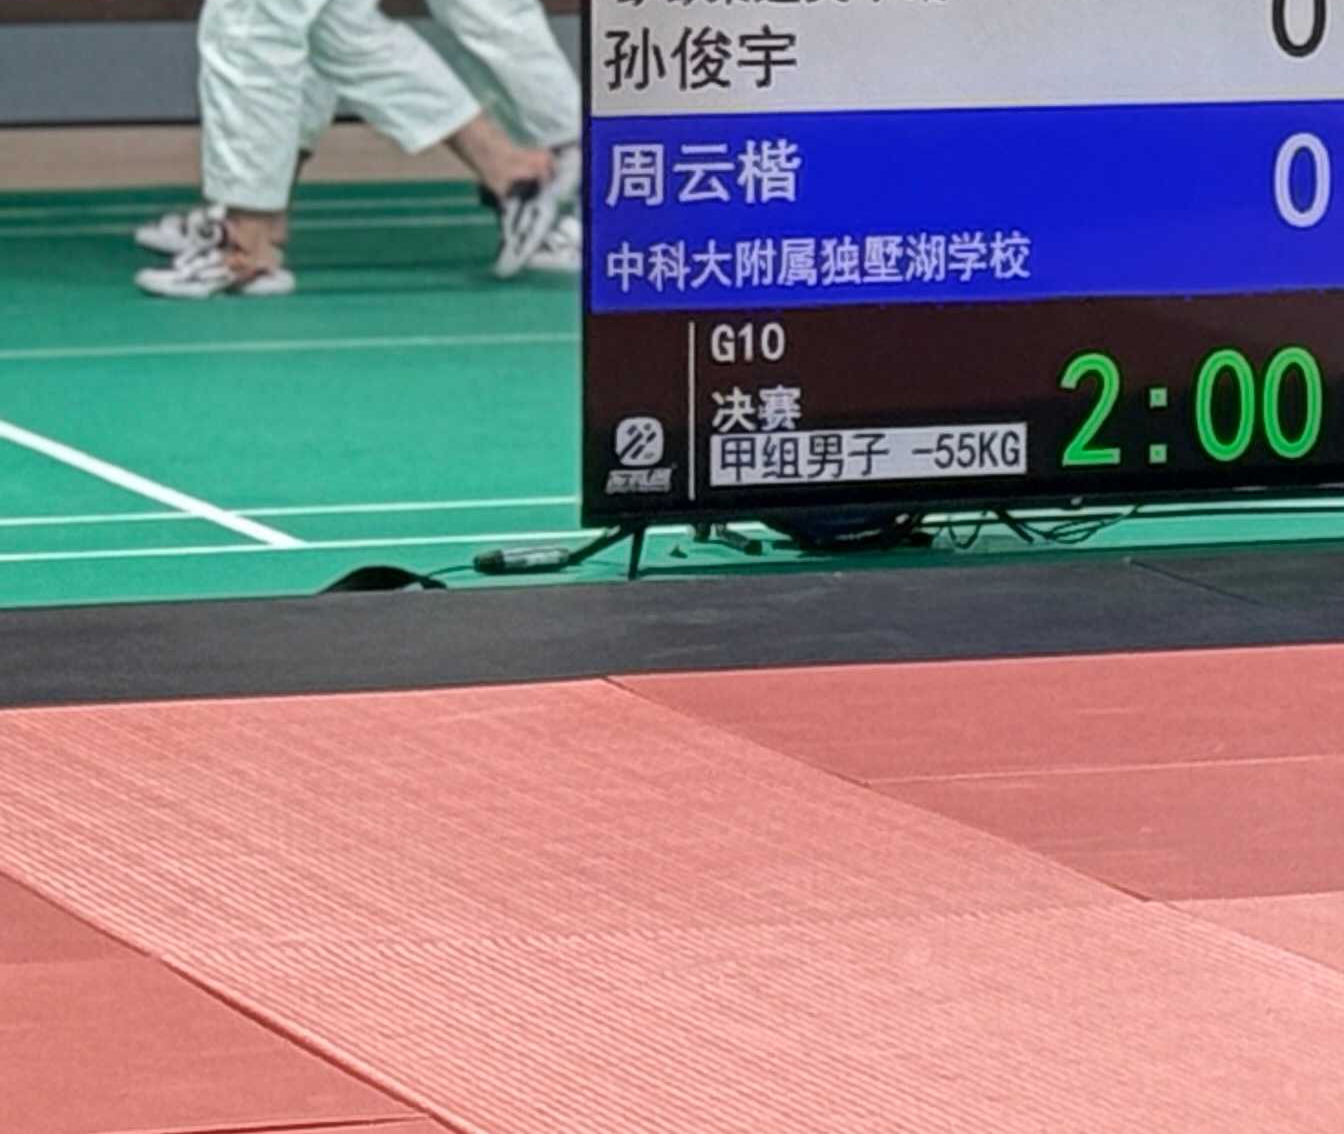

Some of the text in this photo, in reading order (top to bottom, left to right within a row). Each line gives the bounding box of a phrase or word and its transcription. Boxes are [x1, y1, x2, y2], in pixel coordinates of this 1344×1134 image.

[603, 24, 798, 91] 孙俊宇
[605, 138, 802, 207] 周云楷
[1274, 132, 1331, 228] 0
[606, 229, 1033, 294] 中科大附属独墅湖学校
[711, 322, 786, 362] G10
[711, 385, 802, 432] 决赛
[1060, 346, 1323, 466] 2:00
[719, 433, 891, 483] 甲组男子
[911, 430, 1021, 469] -55KG
